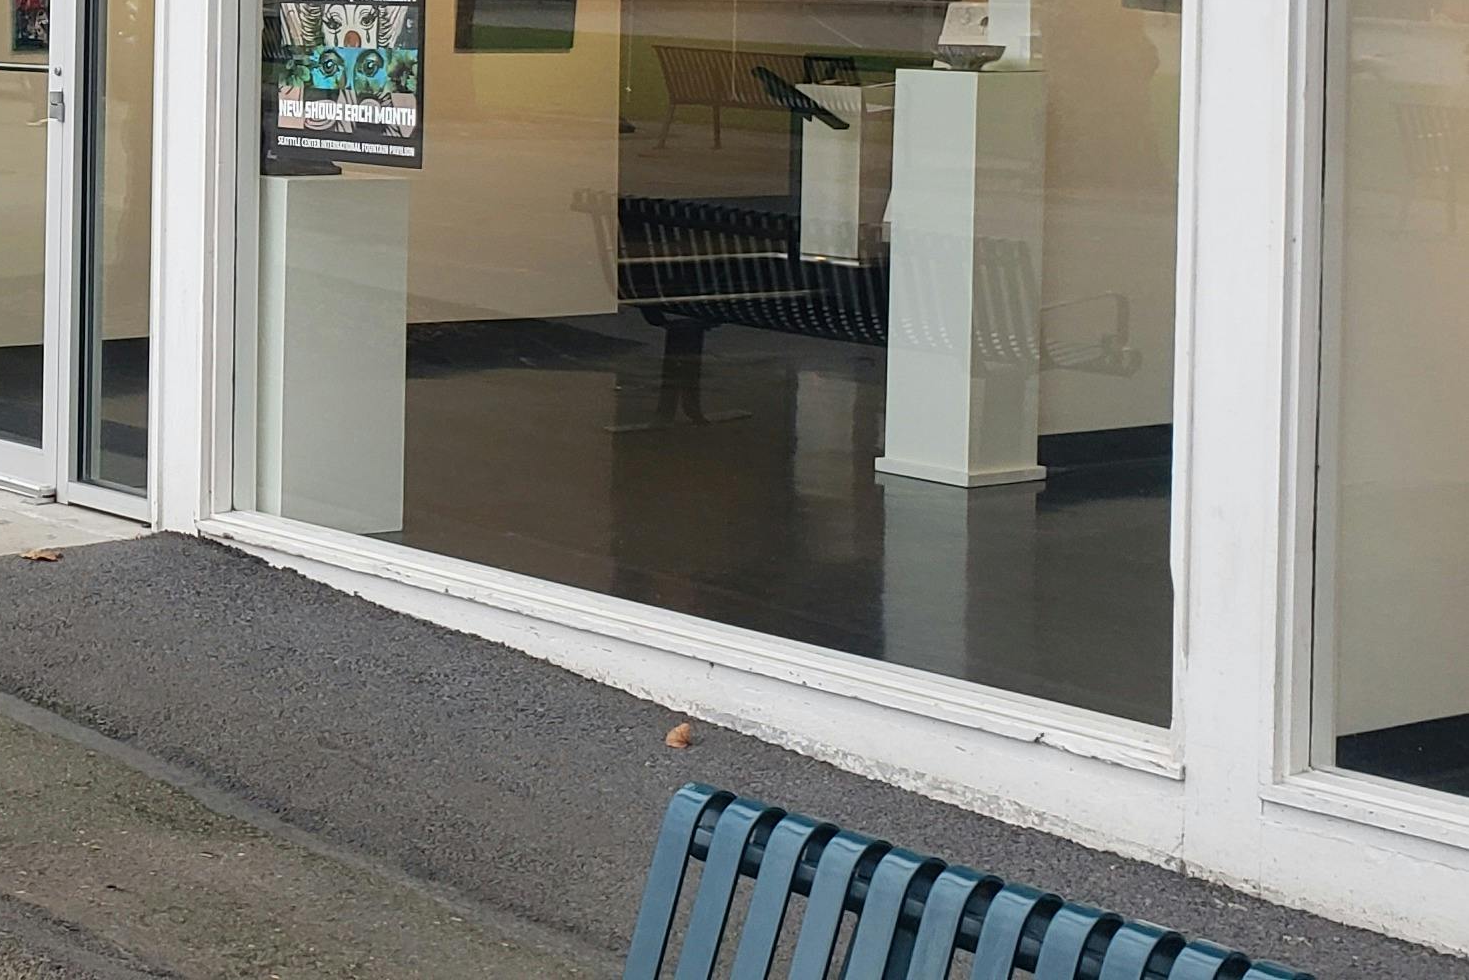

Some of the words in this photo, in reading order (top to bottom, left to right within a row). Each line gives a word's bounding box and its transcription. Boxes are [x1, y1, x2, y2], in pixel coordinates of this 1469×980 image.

[279, 99, 303, 118] NEW
[304, 101, 342, 121] SHOWS
[344, 104, 373, 123] EACH
[374, 106, 416, 127] MONTH
[277, 135, 301, 147] SEATTLE
